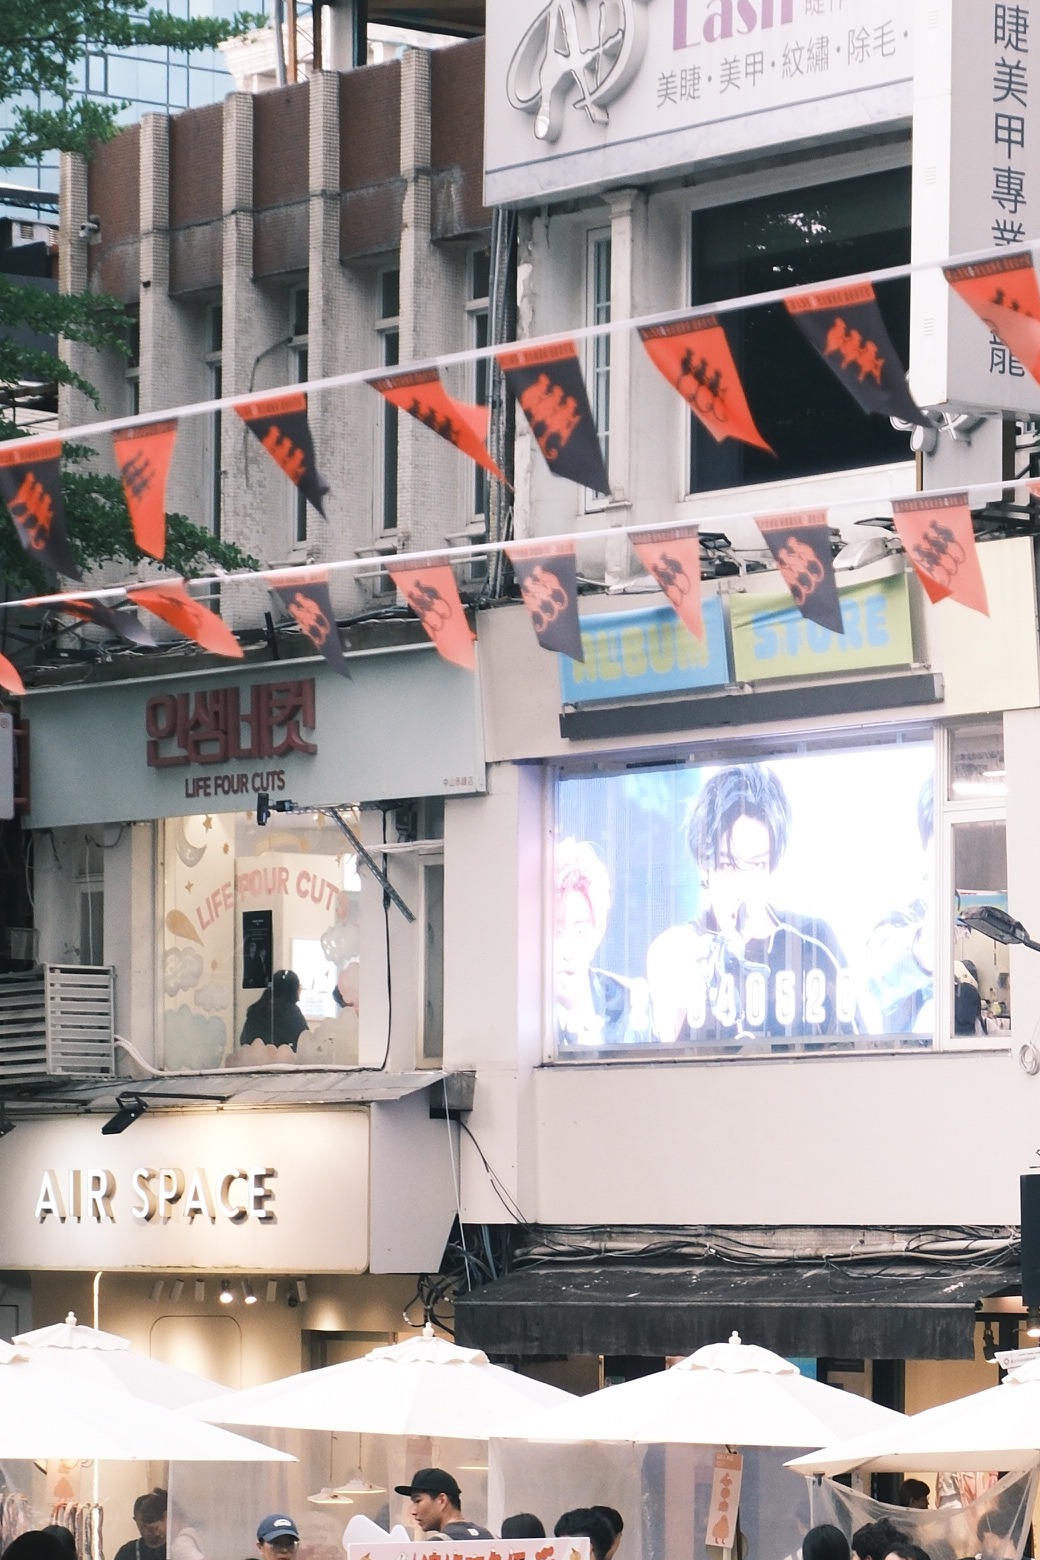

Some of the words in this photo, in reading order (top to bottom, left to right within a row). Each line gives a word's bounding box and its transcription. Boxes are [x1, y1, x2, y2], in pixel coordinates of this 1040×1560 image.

[990, 3, 1029, 377] 睫美甲專業龍
[185, 777, 212, 798] LIFE
[214, 773, 249, 796] FOUR
[251, 769, 286, 793] CUTS
[195, 881, 235, 931] LIFE
[236, 866, 290, 902] FOUR
[295, 870, 350, 921] CUTS
[34, 1168, 116, 1221] AIR
[131, 1167, 275, 1222] SPACE
